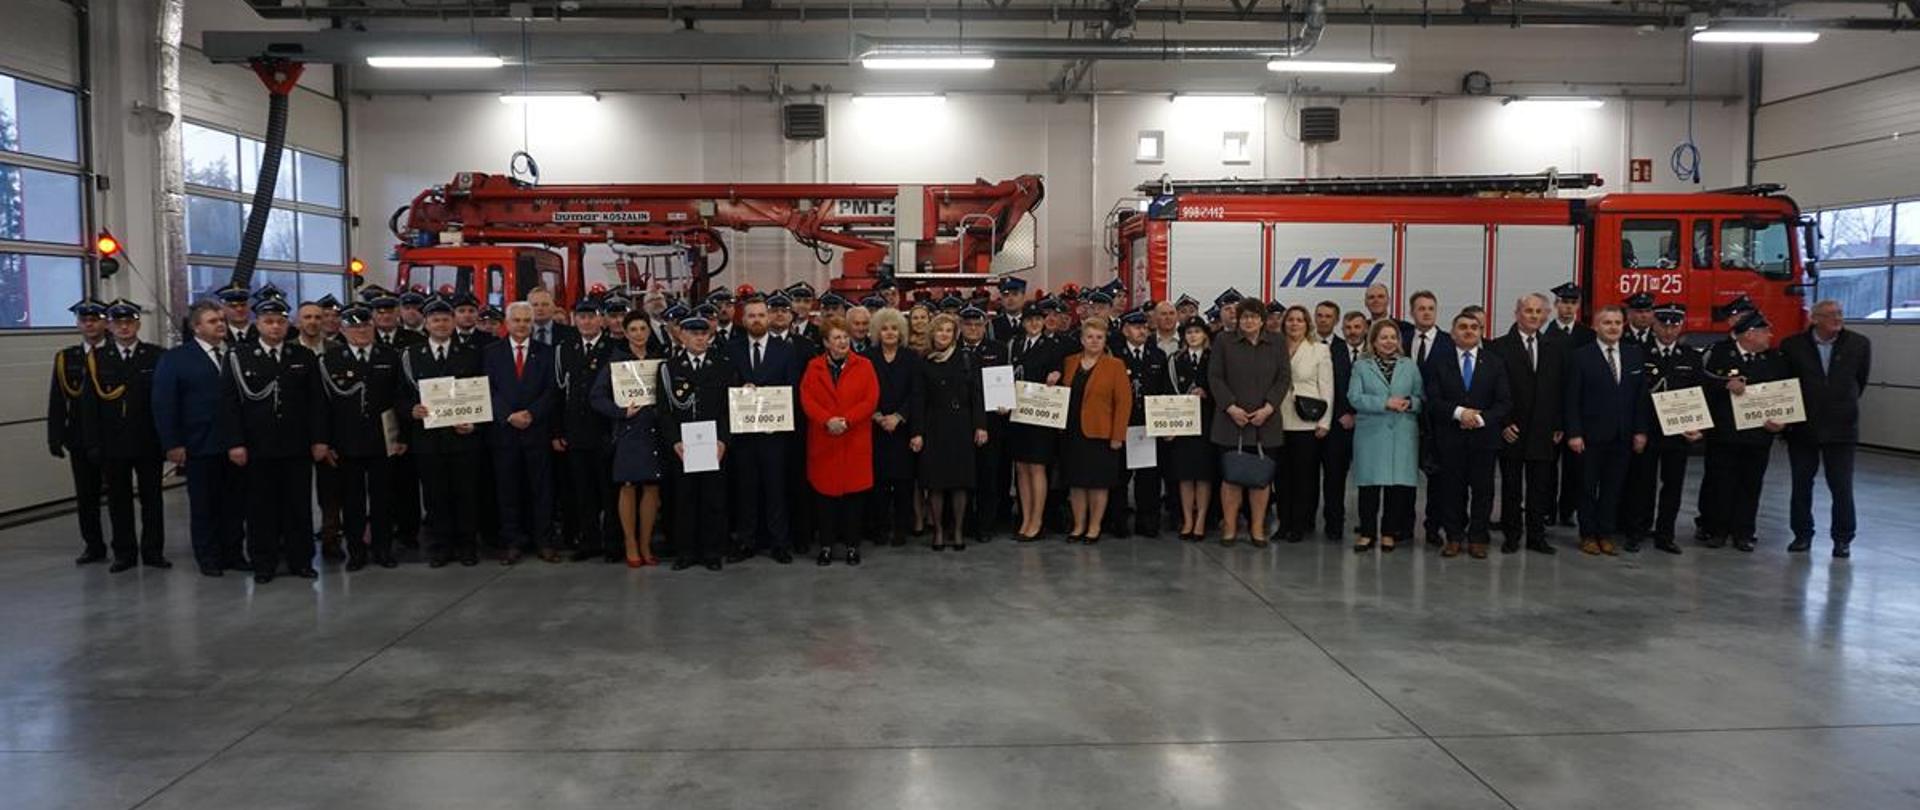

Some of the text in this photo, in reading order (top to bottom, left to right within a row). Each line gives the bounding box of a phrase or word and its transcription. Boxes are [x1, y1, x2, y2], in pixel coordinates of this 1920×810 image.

[602, 213, 648, 221] KOSZALIN
[1620, 274, 1648, 294] 671
[1661, 274, 1682, 294] 25
